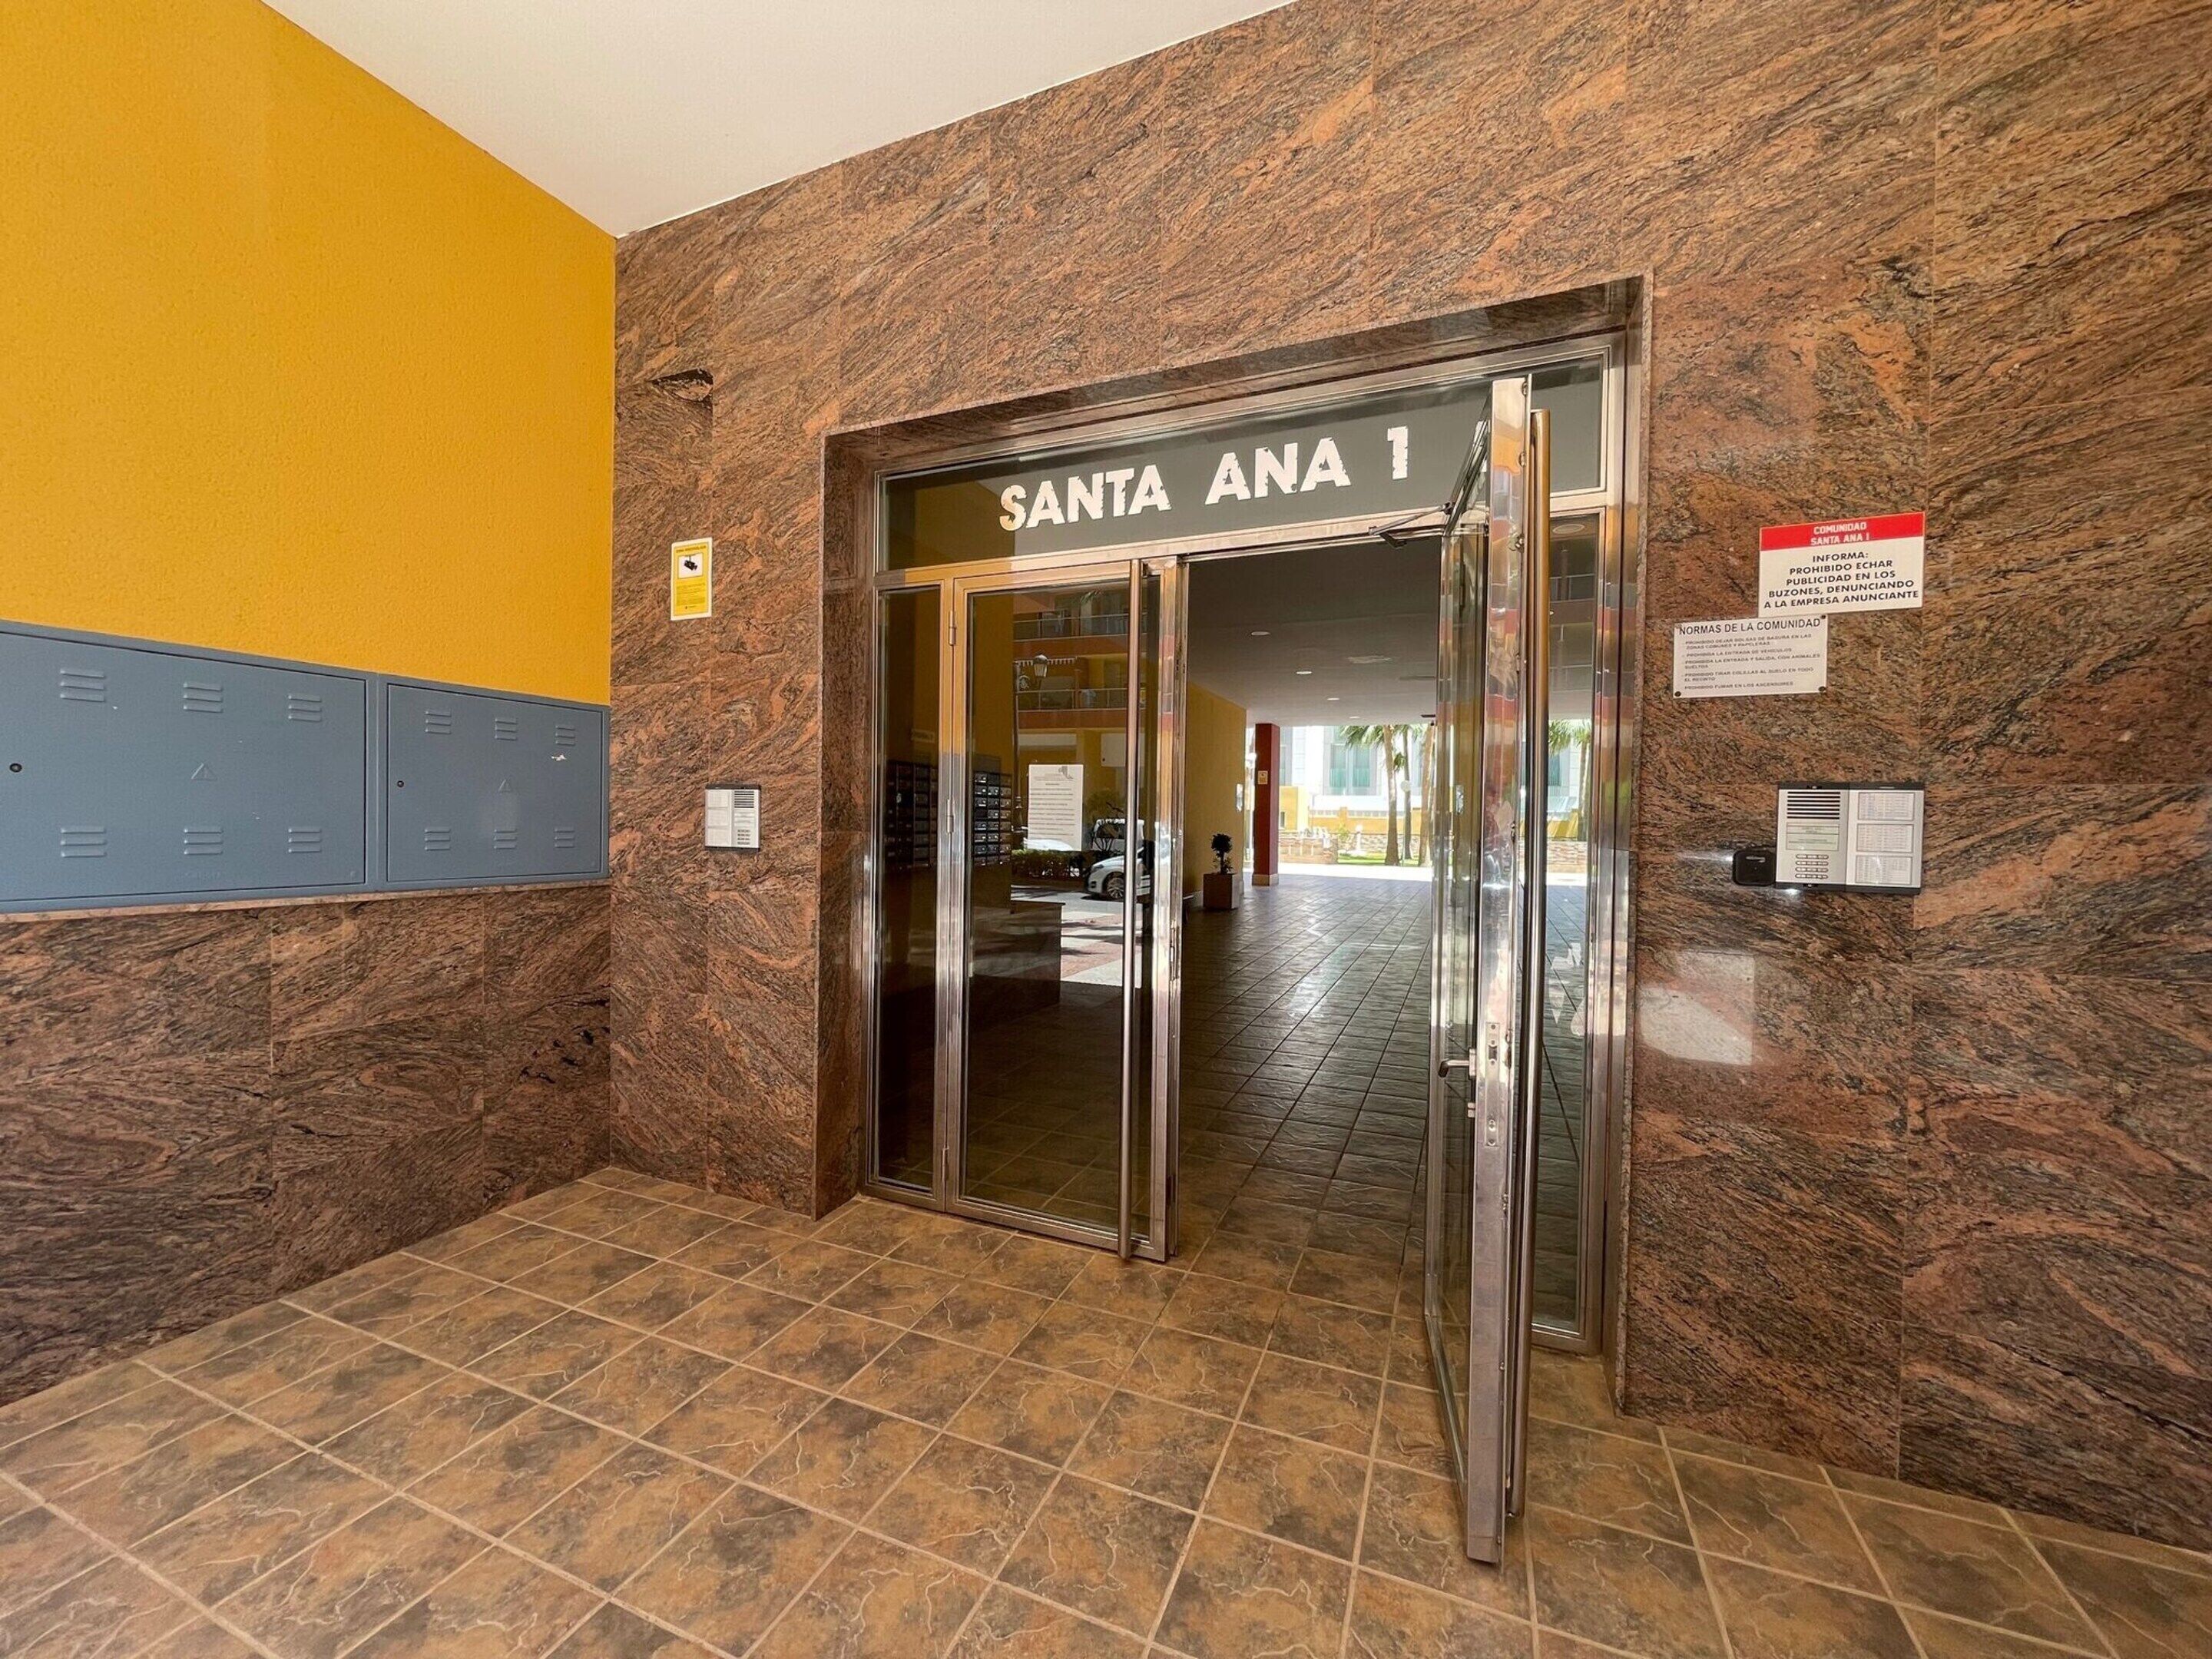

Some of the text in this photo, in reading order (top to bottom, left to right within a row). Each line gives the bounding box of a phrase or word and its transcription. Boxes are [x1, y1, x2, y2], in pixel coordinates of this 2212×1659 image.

[998, 426, 1409, 532] SANTA ANA 1
[1813, 522, 1867, 535] COMUNIDAD
[1810, 536, 1839, 545] SANTA
[1843, 533, 1863, 542] ANA
[1813, 551, 1869, 562] INFORMA:
[1790, 560, 1892, 575] PROHIBIDO ECHAR
[1786, 574, 1852, 586] PUBLICIDAD
[1874, 570, 1896, 579] LOS
[1769, 580, 1914, 598] BUZONES, DENUNCIANDO
[1790, 597, 1839, 607] EMPRESA
[1843, 591, 1919, 603] ANUNCIANTE
[1679, 618, 1820, 635] NORMAS DE LA COMUNIDAD
